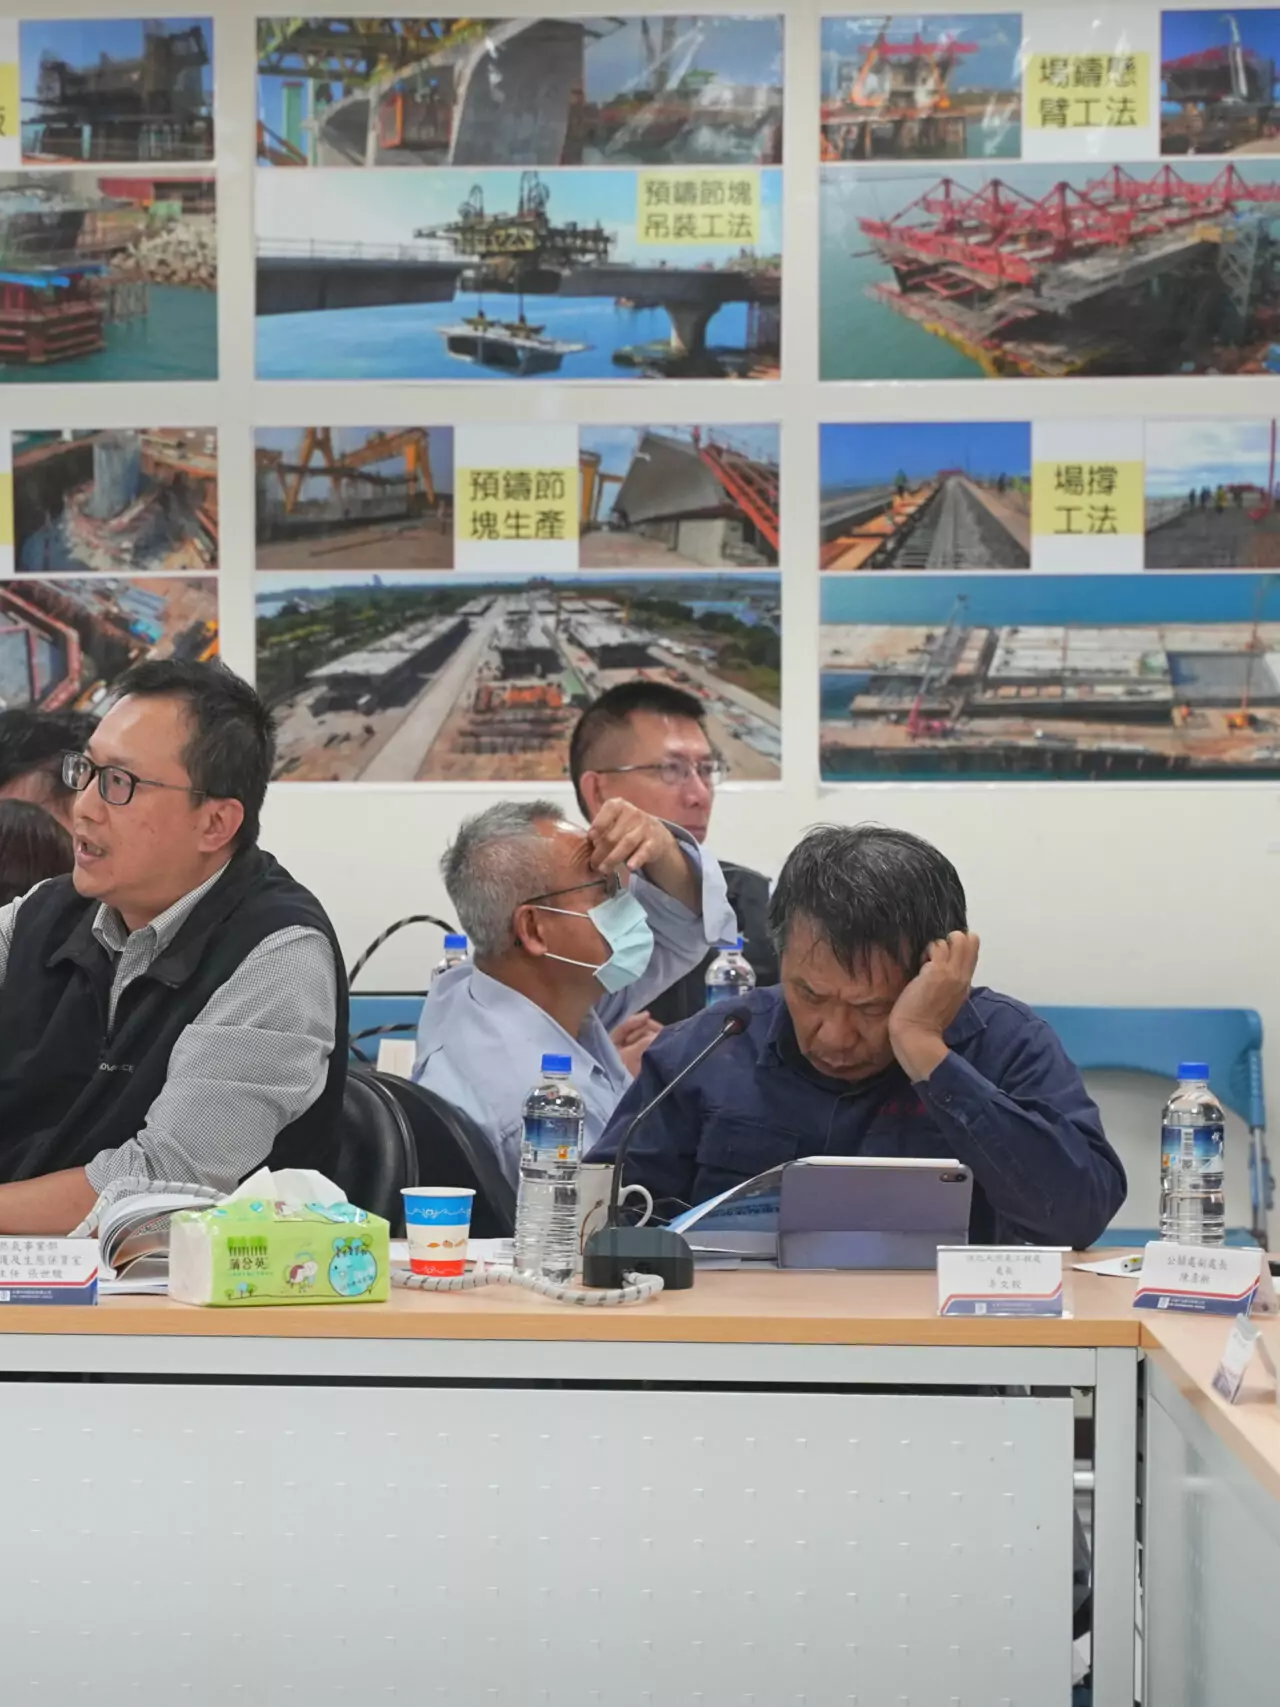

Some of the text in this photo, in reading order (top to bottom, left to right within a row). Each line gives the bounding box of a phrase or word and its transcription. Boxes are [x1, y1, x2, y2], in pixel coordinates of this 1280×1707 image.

[1038, 96, 1137, 128] 臂工法
[644, 179, 752, 206] 預鑄節塊
[644, 212, 752, 239] 吊裝工法
[469, 470, 565, 501] 預鑄節
[1054, 465, 1118, 496] 場撐
[469, 509, 565, 541] 塊生產
[1054, 504, 1118, 535] 工法
